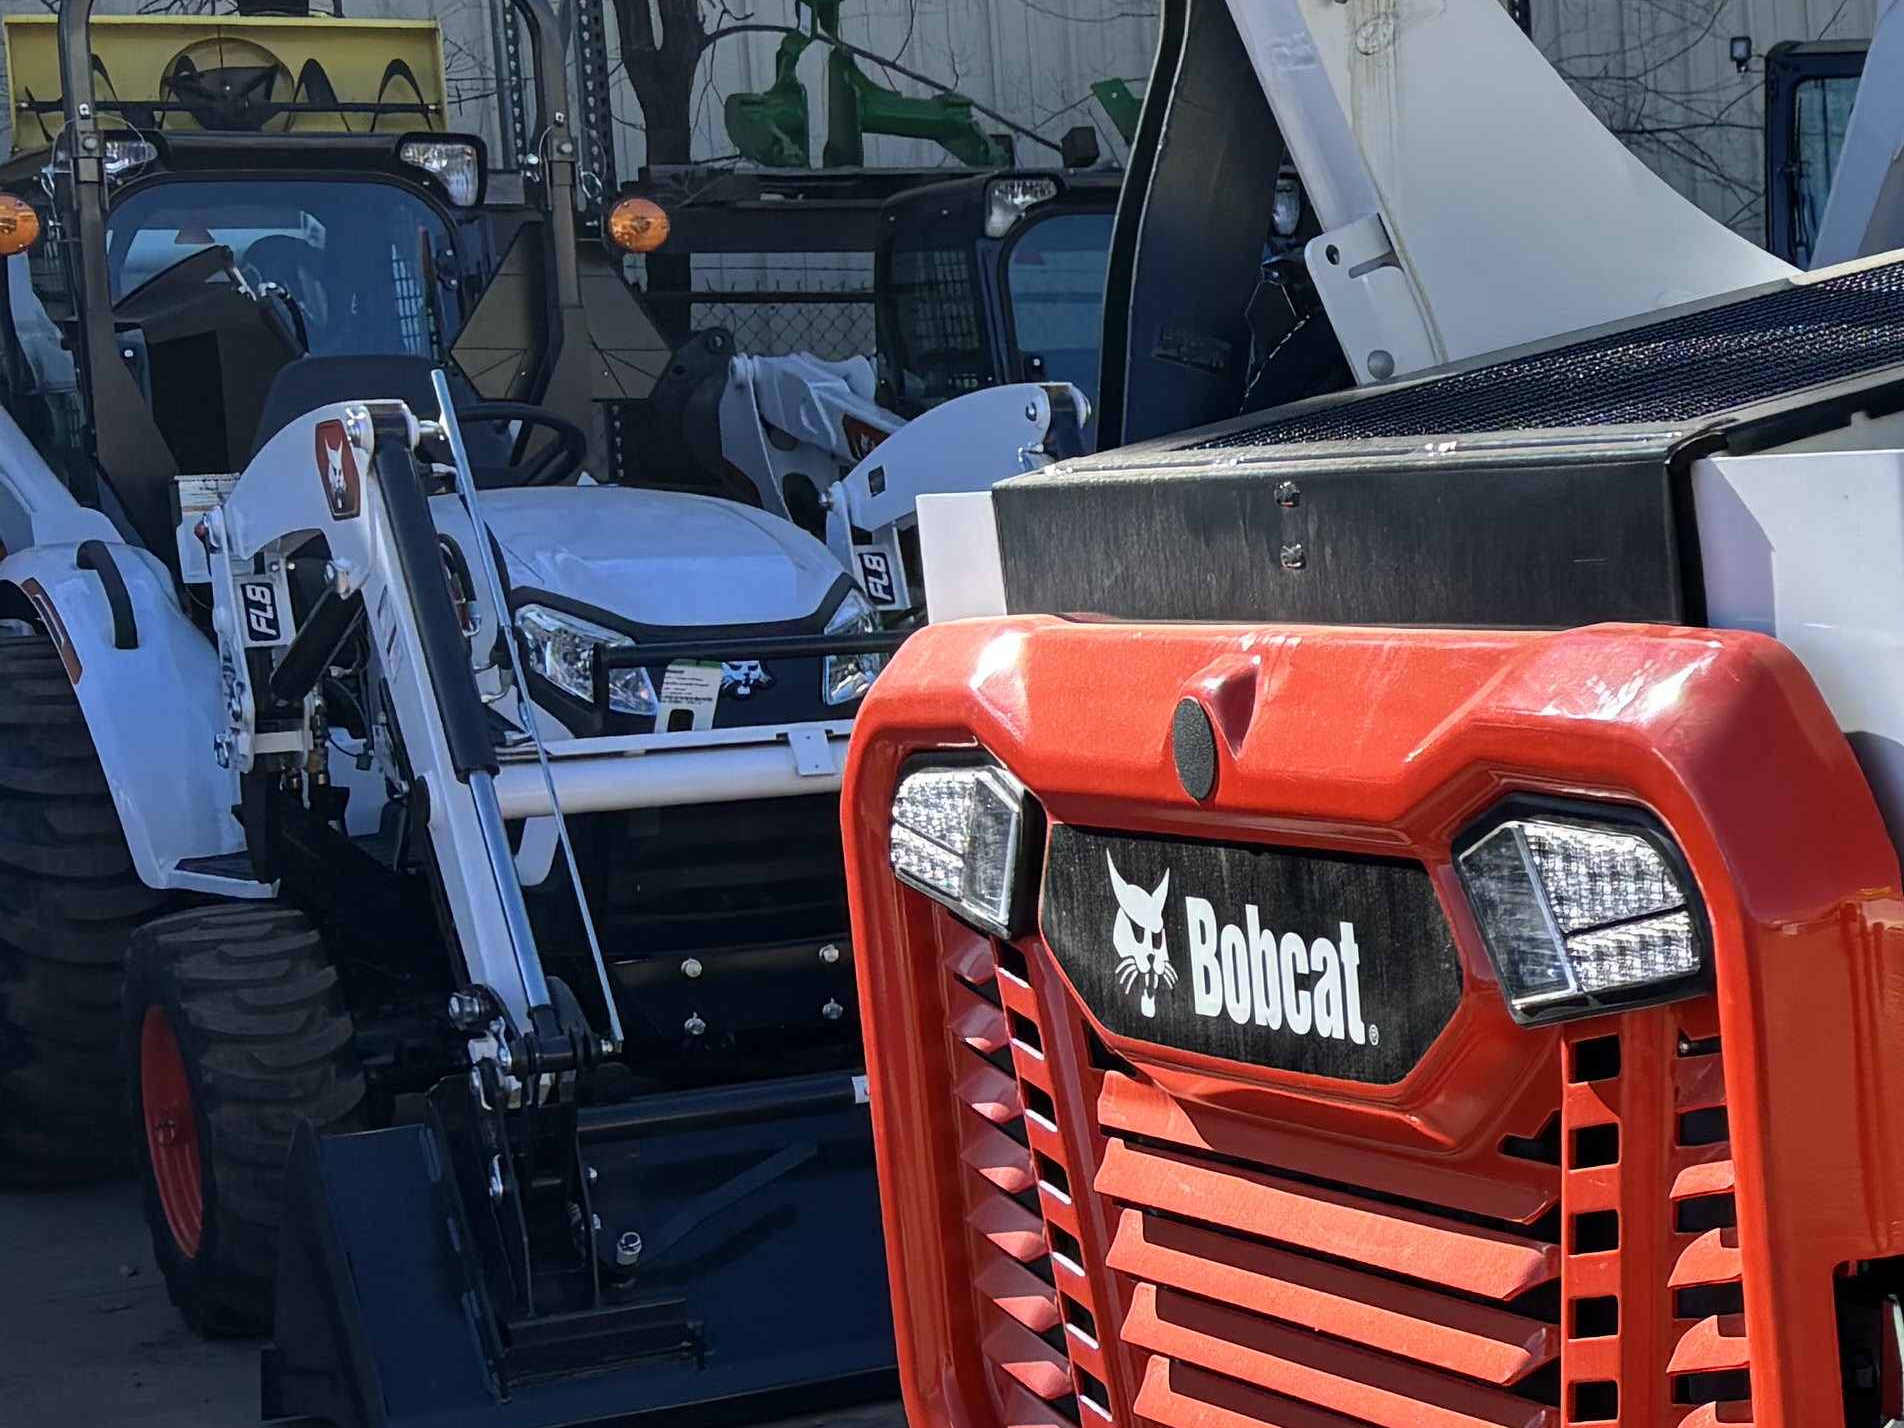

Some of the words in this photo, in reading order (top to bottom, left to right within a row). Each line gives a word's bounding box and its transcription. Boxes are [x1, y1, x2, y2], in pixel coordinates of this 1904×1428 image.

[863, 554, 893, 602] FL8
[245, 584, 278, 636] FL8
[1185, 895, 1366, 1046] Bobcat
